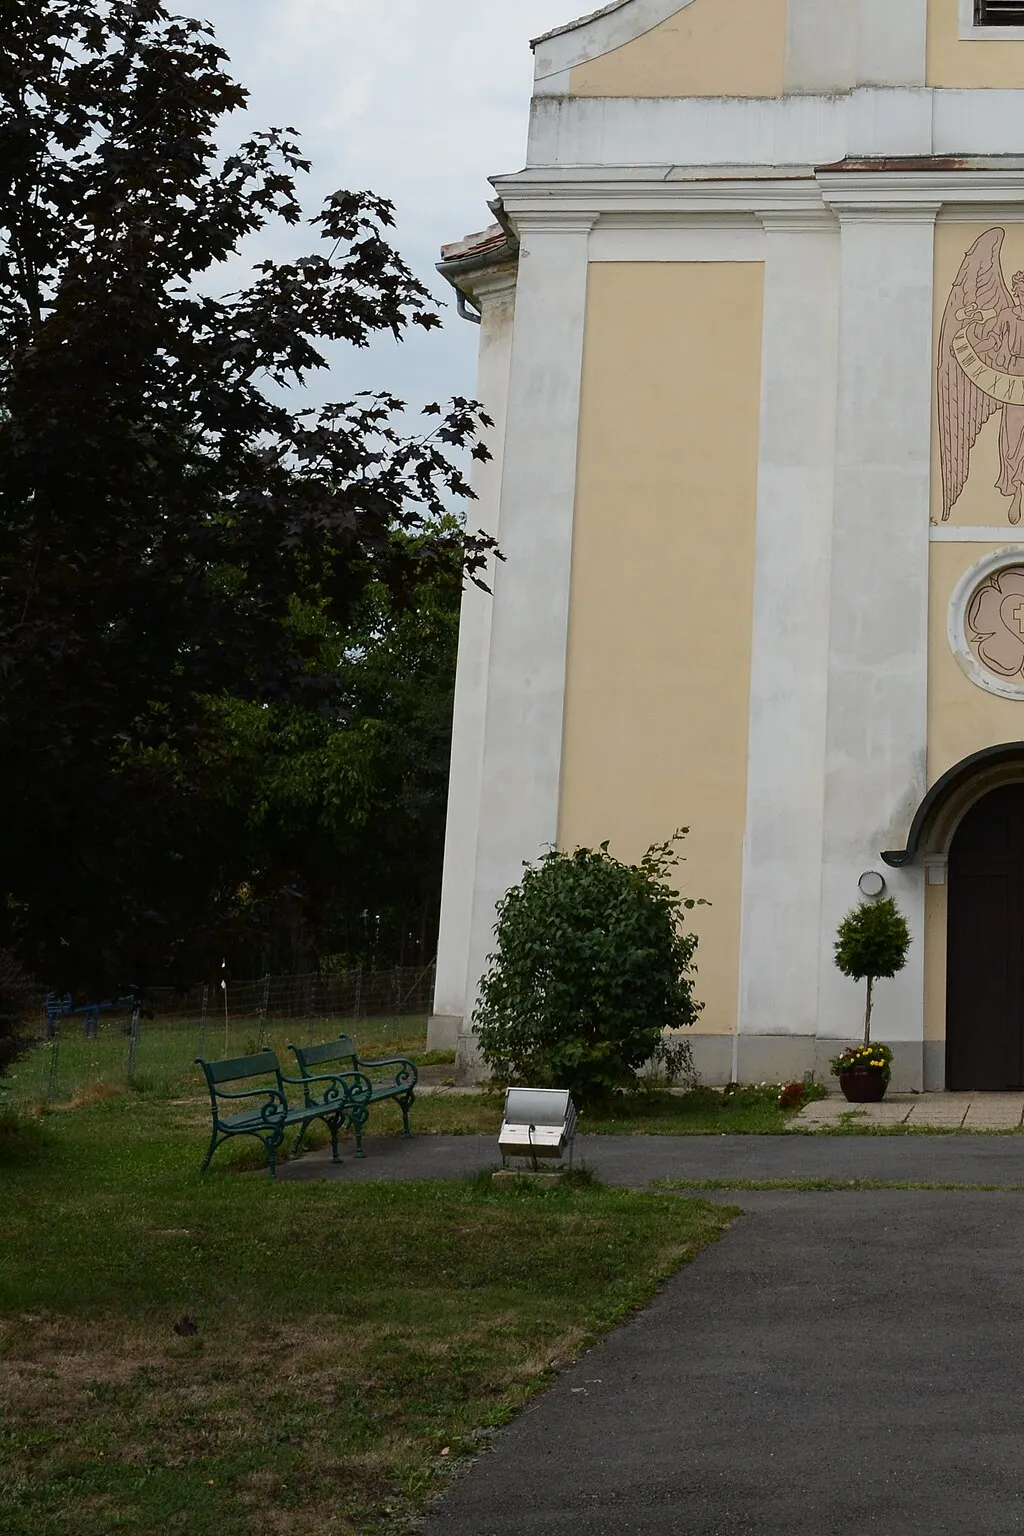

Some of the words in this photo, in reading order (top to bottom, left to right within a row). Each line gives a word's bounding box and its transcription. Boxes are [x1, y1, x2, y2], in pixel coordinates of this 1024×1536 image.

[972, 366, 987, 380] IX
[988, 374, 1001, 394] X
[1004, 379, 1015, 399] XI
